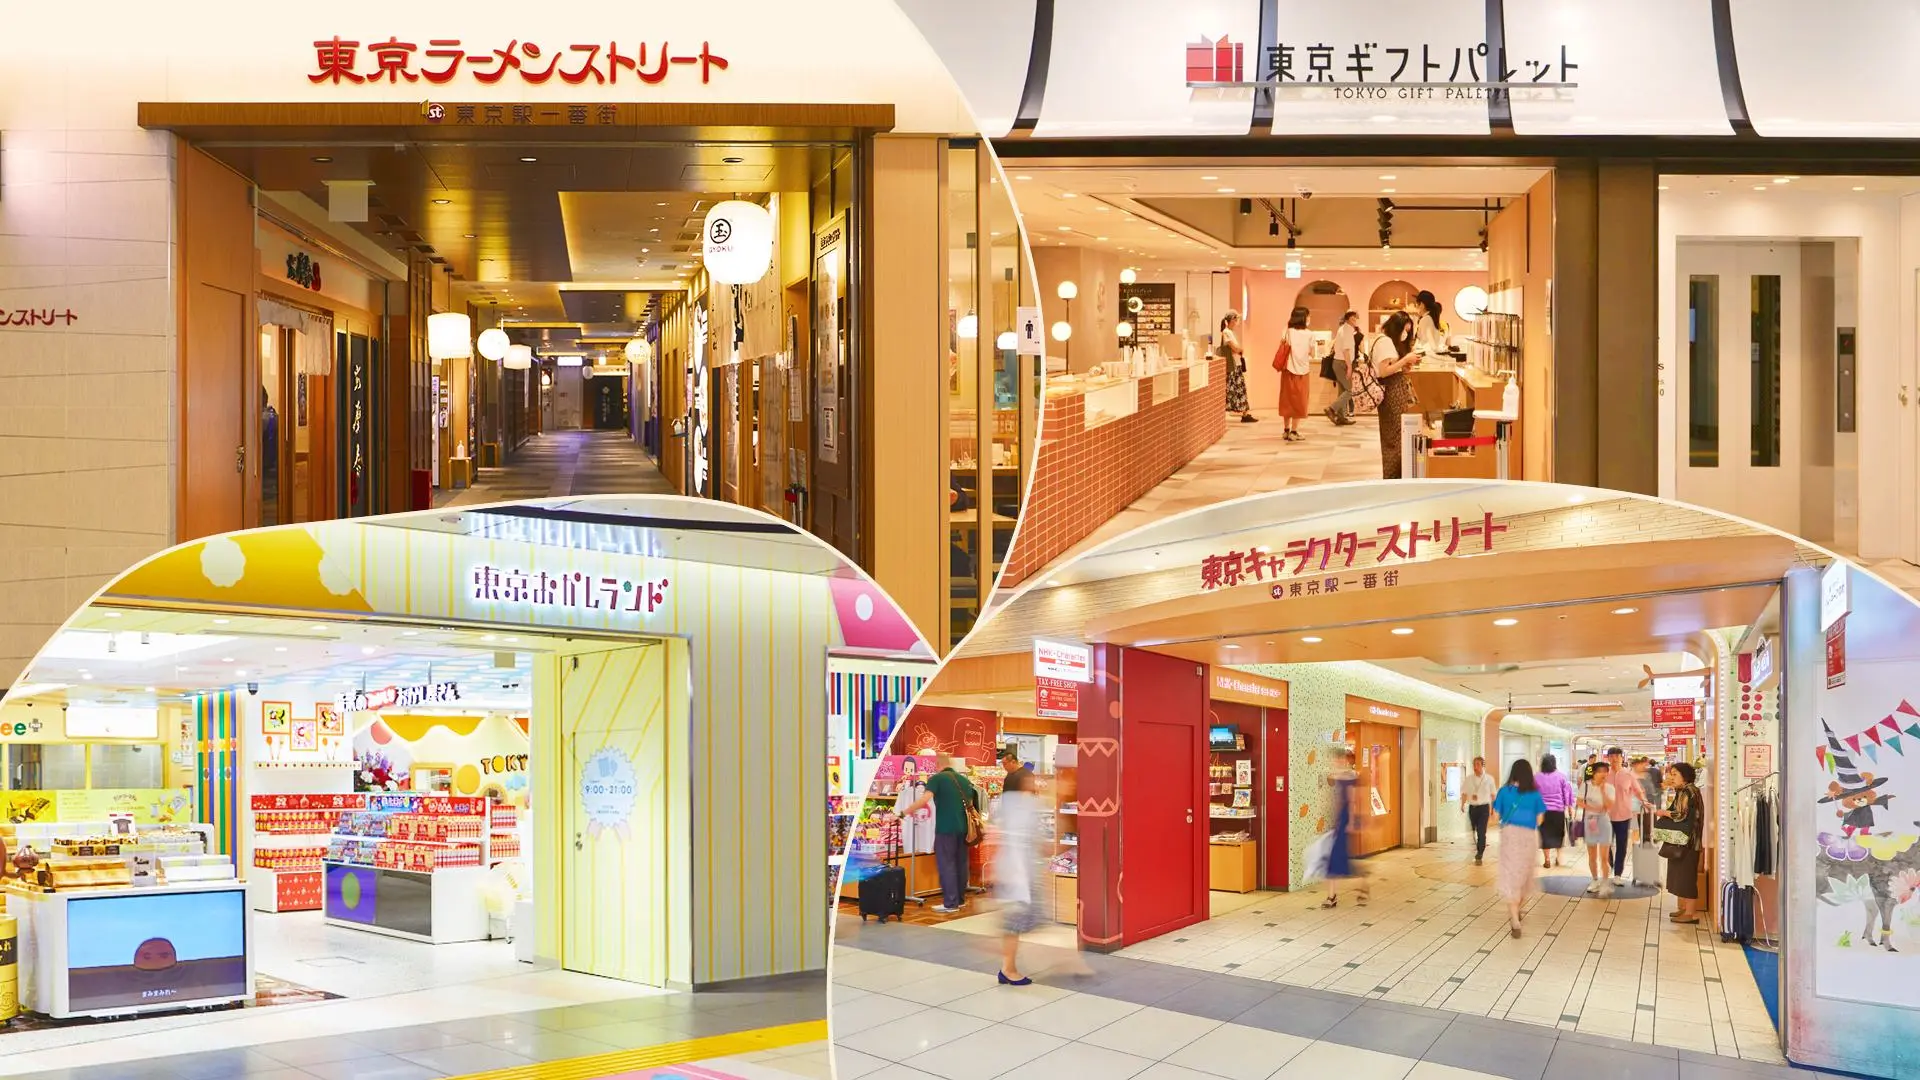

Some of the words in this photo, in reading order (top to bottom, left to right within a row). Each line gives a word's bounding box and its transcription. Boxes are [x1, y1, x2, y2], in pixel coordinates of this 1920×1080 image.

[307, 35, 729, 85] 東京ラーメンストリート
[1266, 43, 1578, 83] 東京ギフトパレット
[1334, 88, 1387, 99] TOKYO
[1398, 88, 1434, 99] GIFT
[456, 103, 618, 125] 東京駅一番街
[0, 308, 78, 326] ンストリート
[1200, 511, 1508, 591] 東京キャラクターストリート
[474, 565, 669, 613] 東京おかしランド
[1289, 569, 1399, 597] 東京駅一番街
